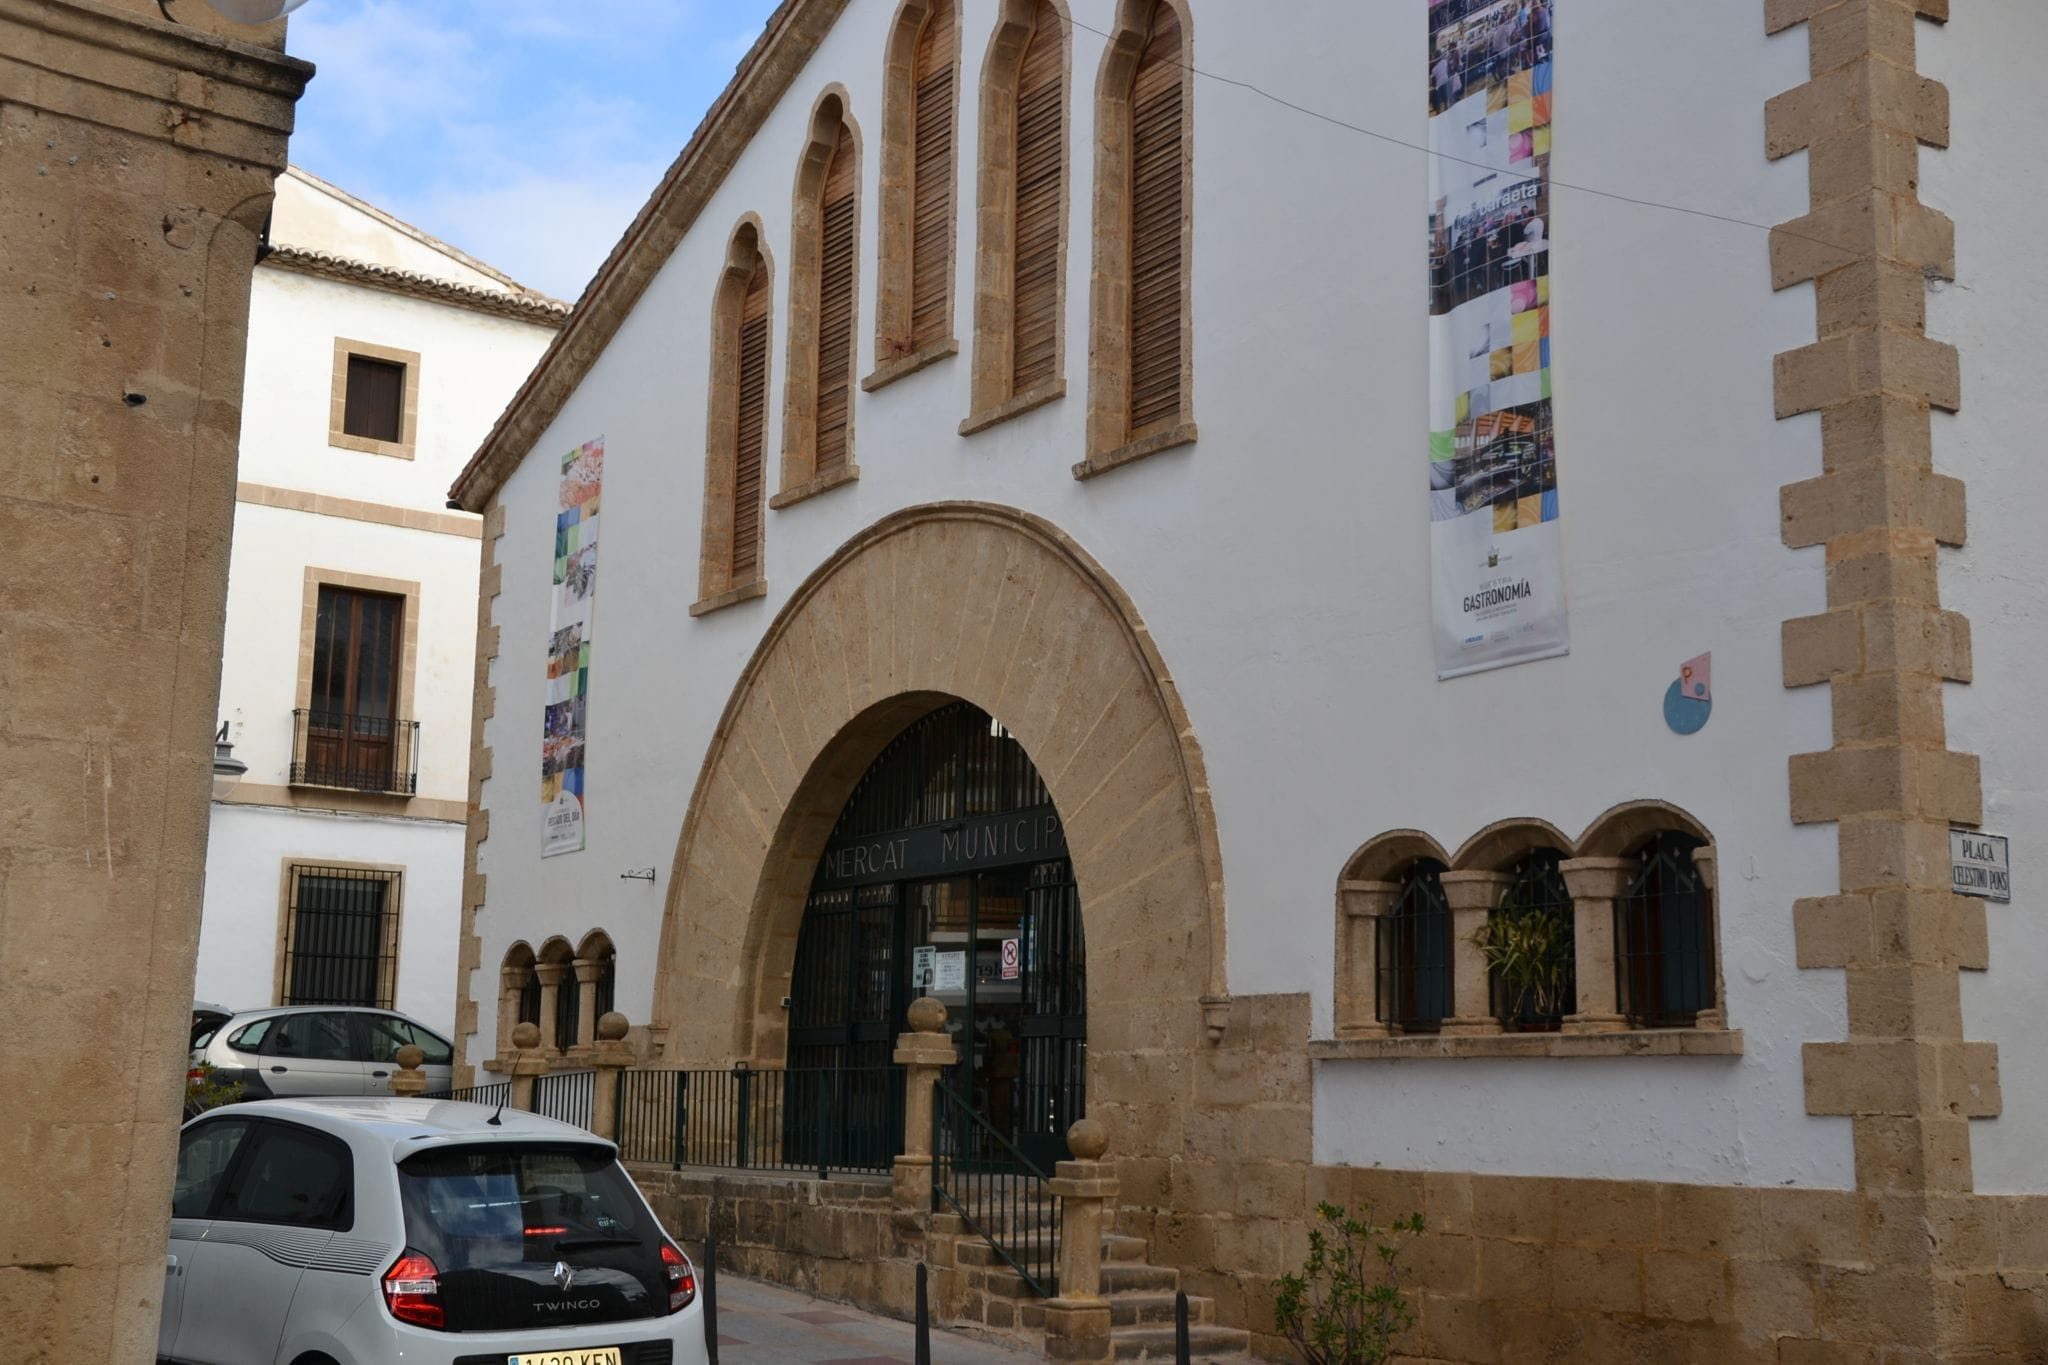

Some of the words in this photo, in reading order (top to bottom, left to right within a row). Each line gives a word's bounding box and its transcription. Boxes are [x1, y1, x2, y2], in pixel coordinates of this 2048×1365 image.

[1463, 579, 1531, 613] GASTRONOMÍA
[825, 838, 909, 880] MERCAT
[1989, 870, 2007, 891] PONS
[532, 1299, 600, 1312] TWINGO
